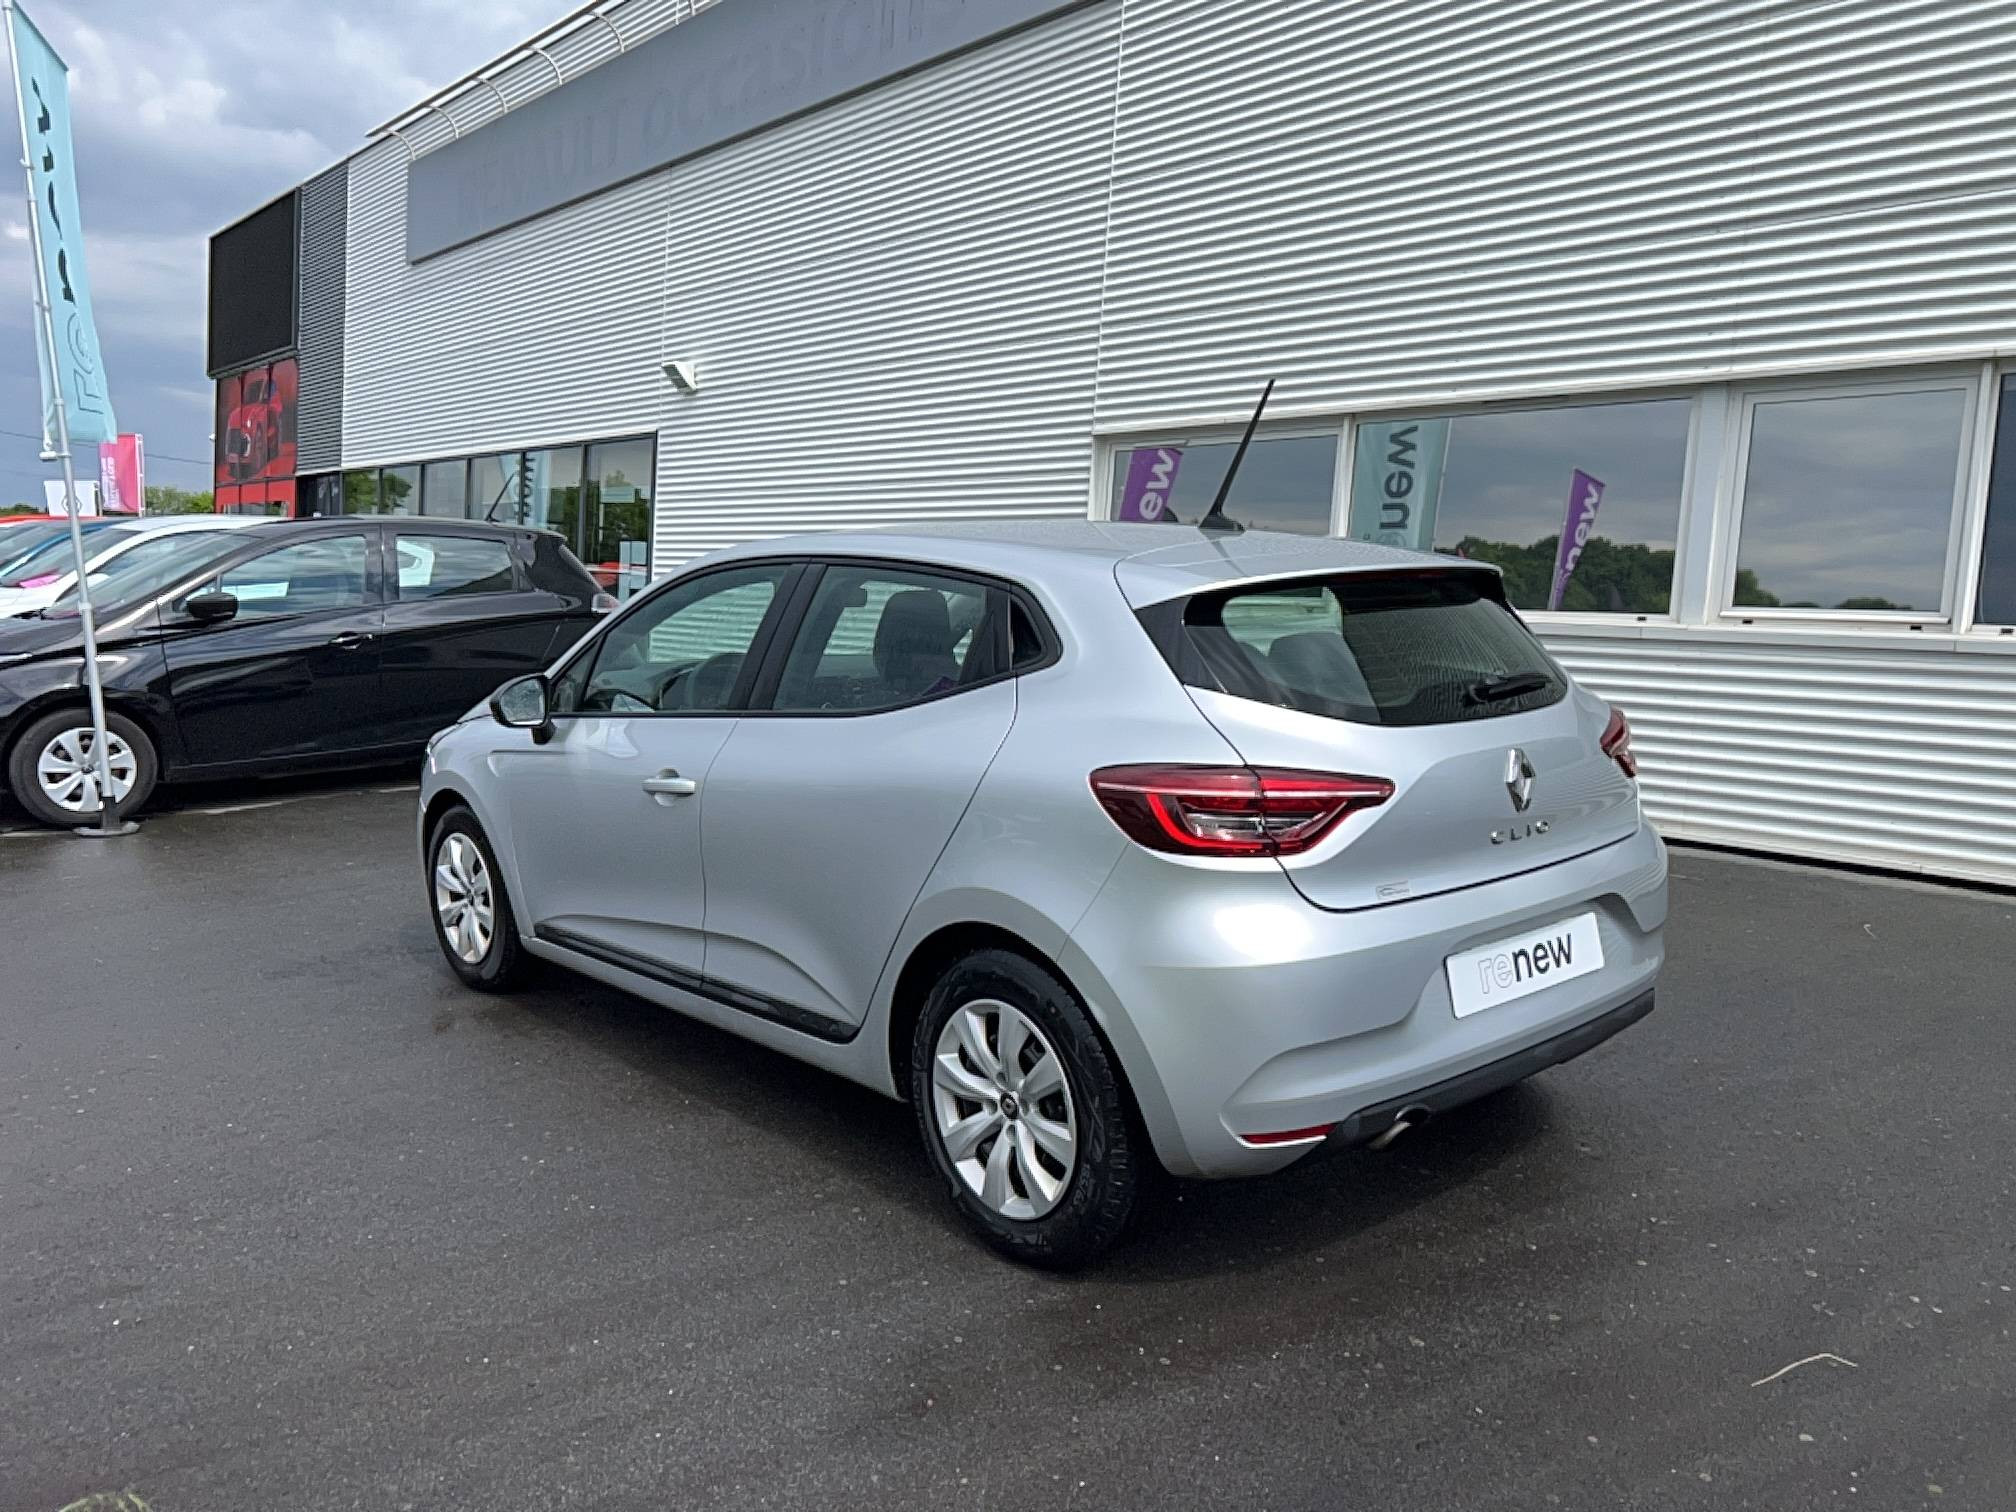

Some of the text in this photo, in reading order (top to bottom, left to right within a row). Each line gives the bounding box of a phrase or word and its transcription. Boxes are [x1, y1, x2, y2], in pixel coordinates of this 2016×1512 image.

[1139, 448, 1174, 520] ew
[1559, 481, 1599, 582] new
[1490, 820, 1550, 845] CLIO
[1478, 931, 1573, 995] renew
